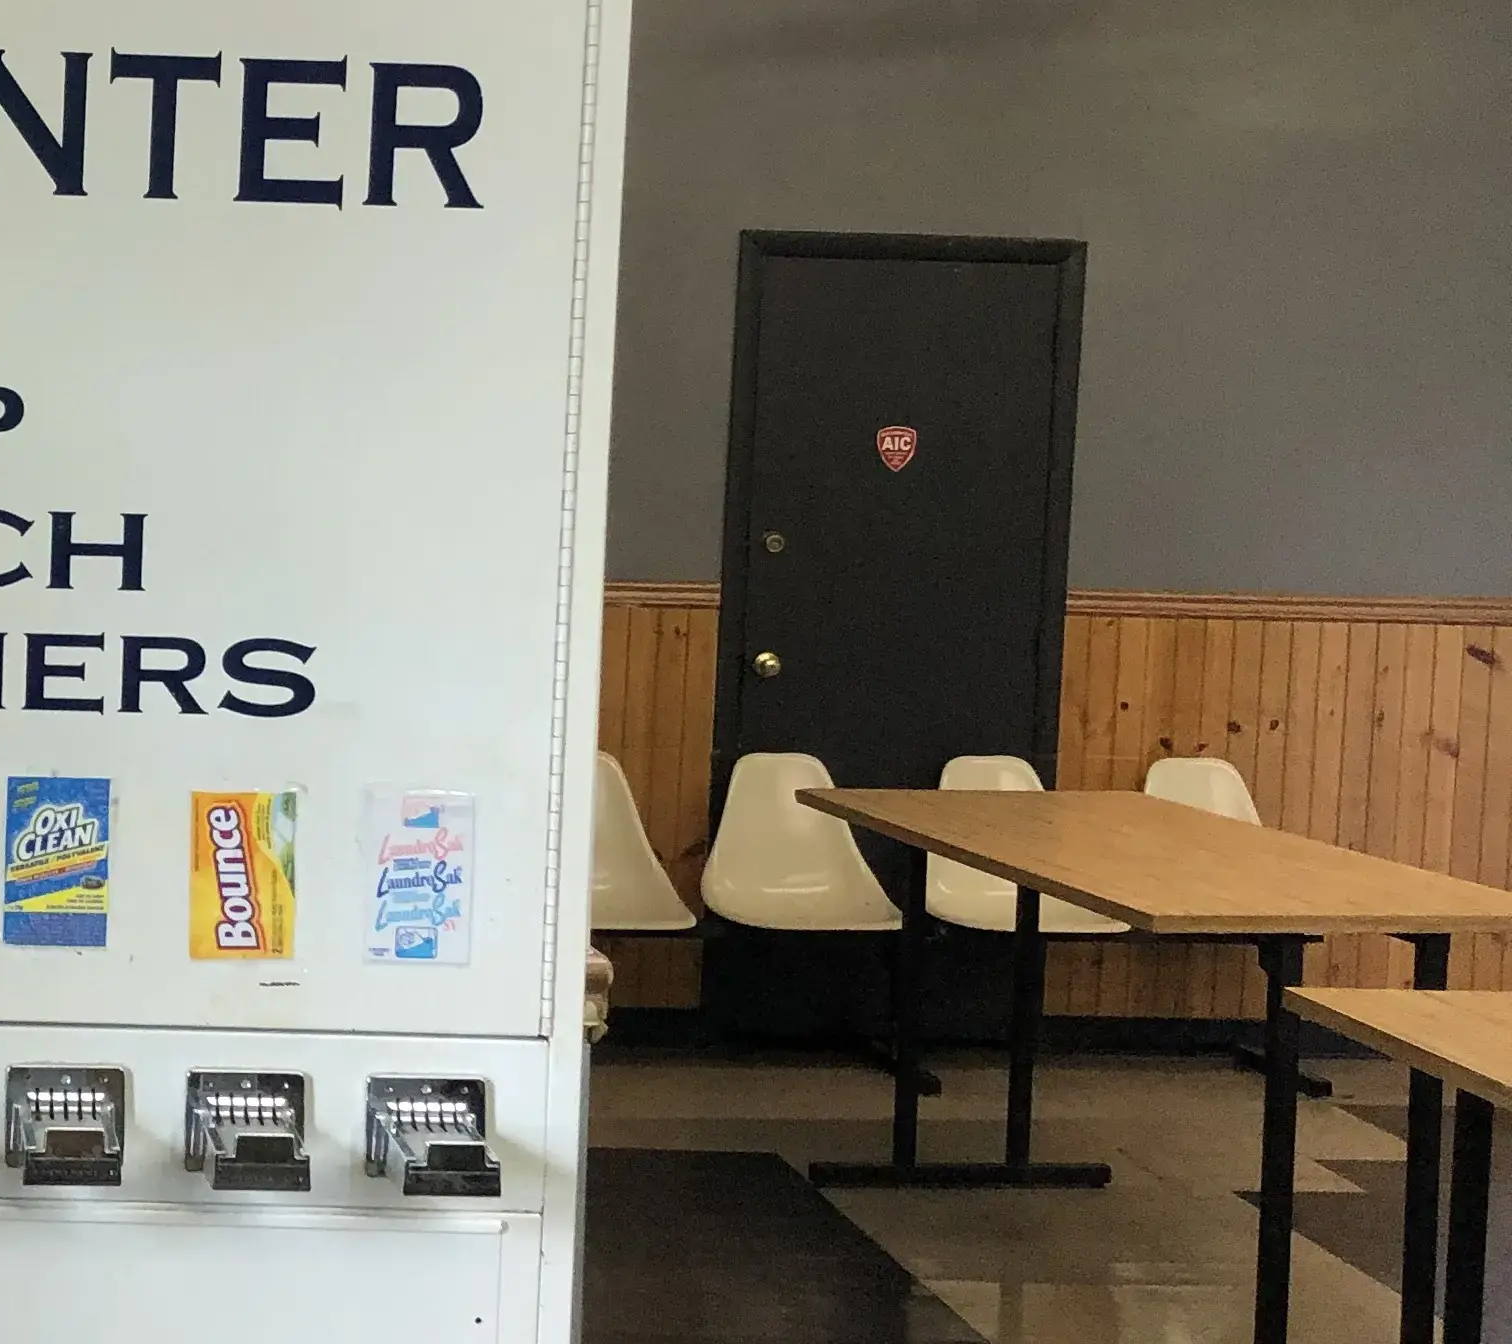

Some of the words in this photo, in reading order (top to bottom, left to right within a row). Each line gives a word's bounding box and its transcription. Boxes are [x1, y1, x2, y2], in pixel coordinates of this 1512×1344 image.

[882, 436, 912, 451] AIC
[35, 807, 79, 835] OXI
[18, 823, 95, 861] CLEAN
[209, 806, 258, 949] Bounce
